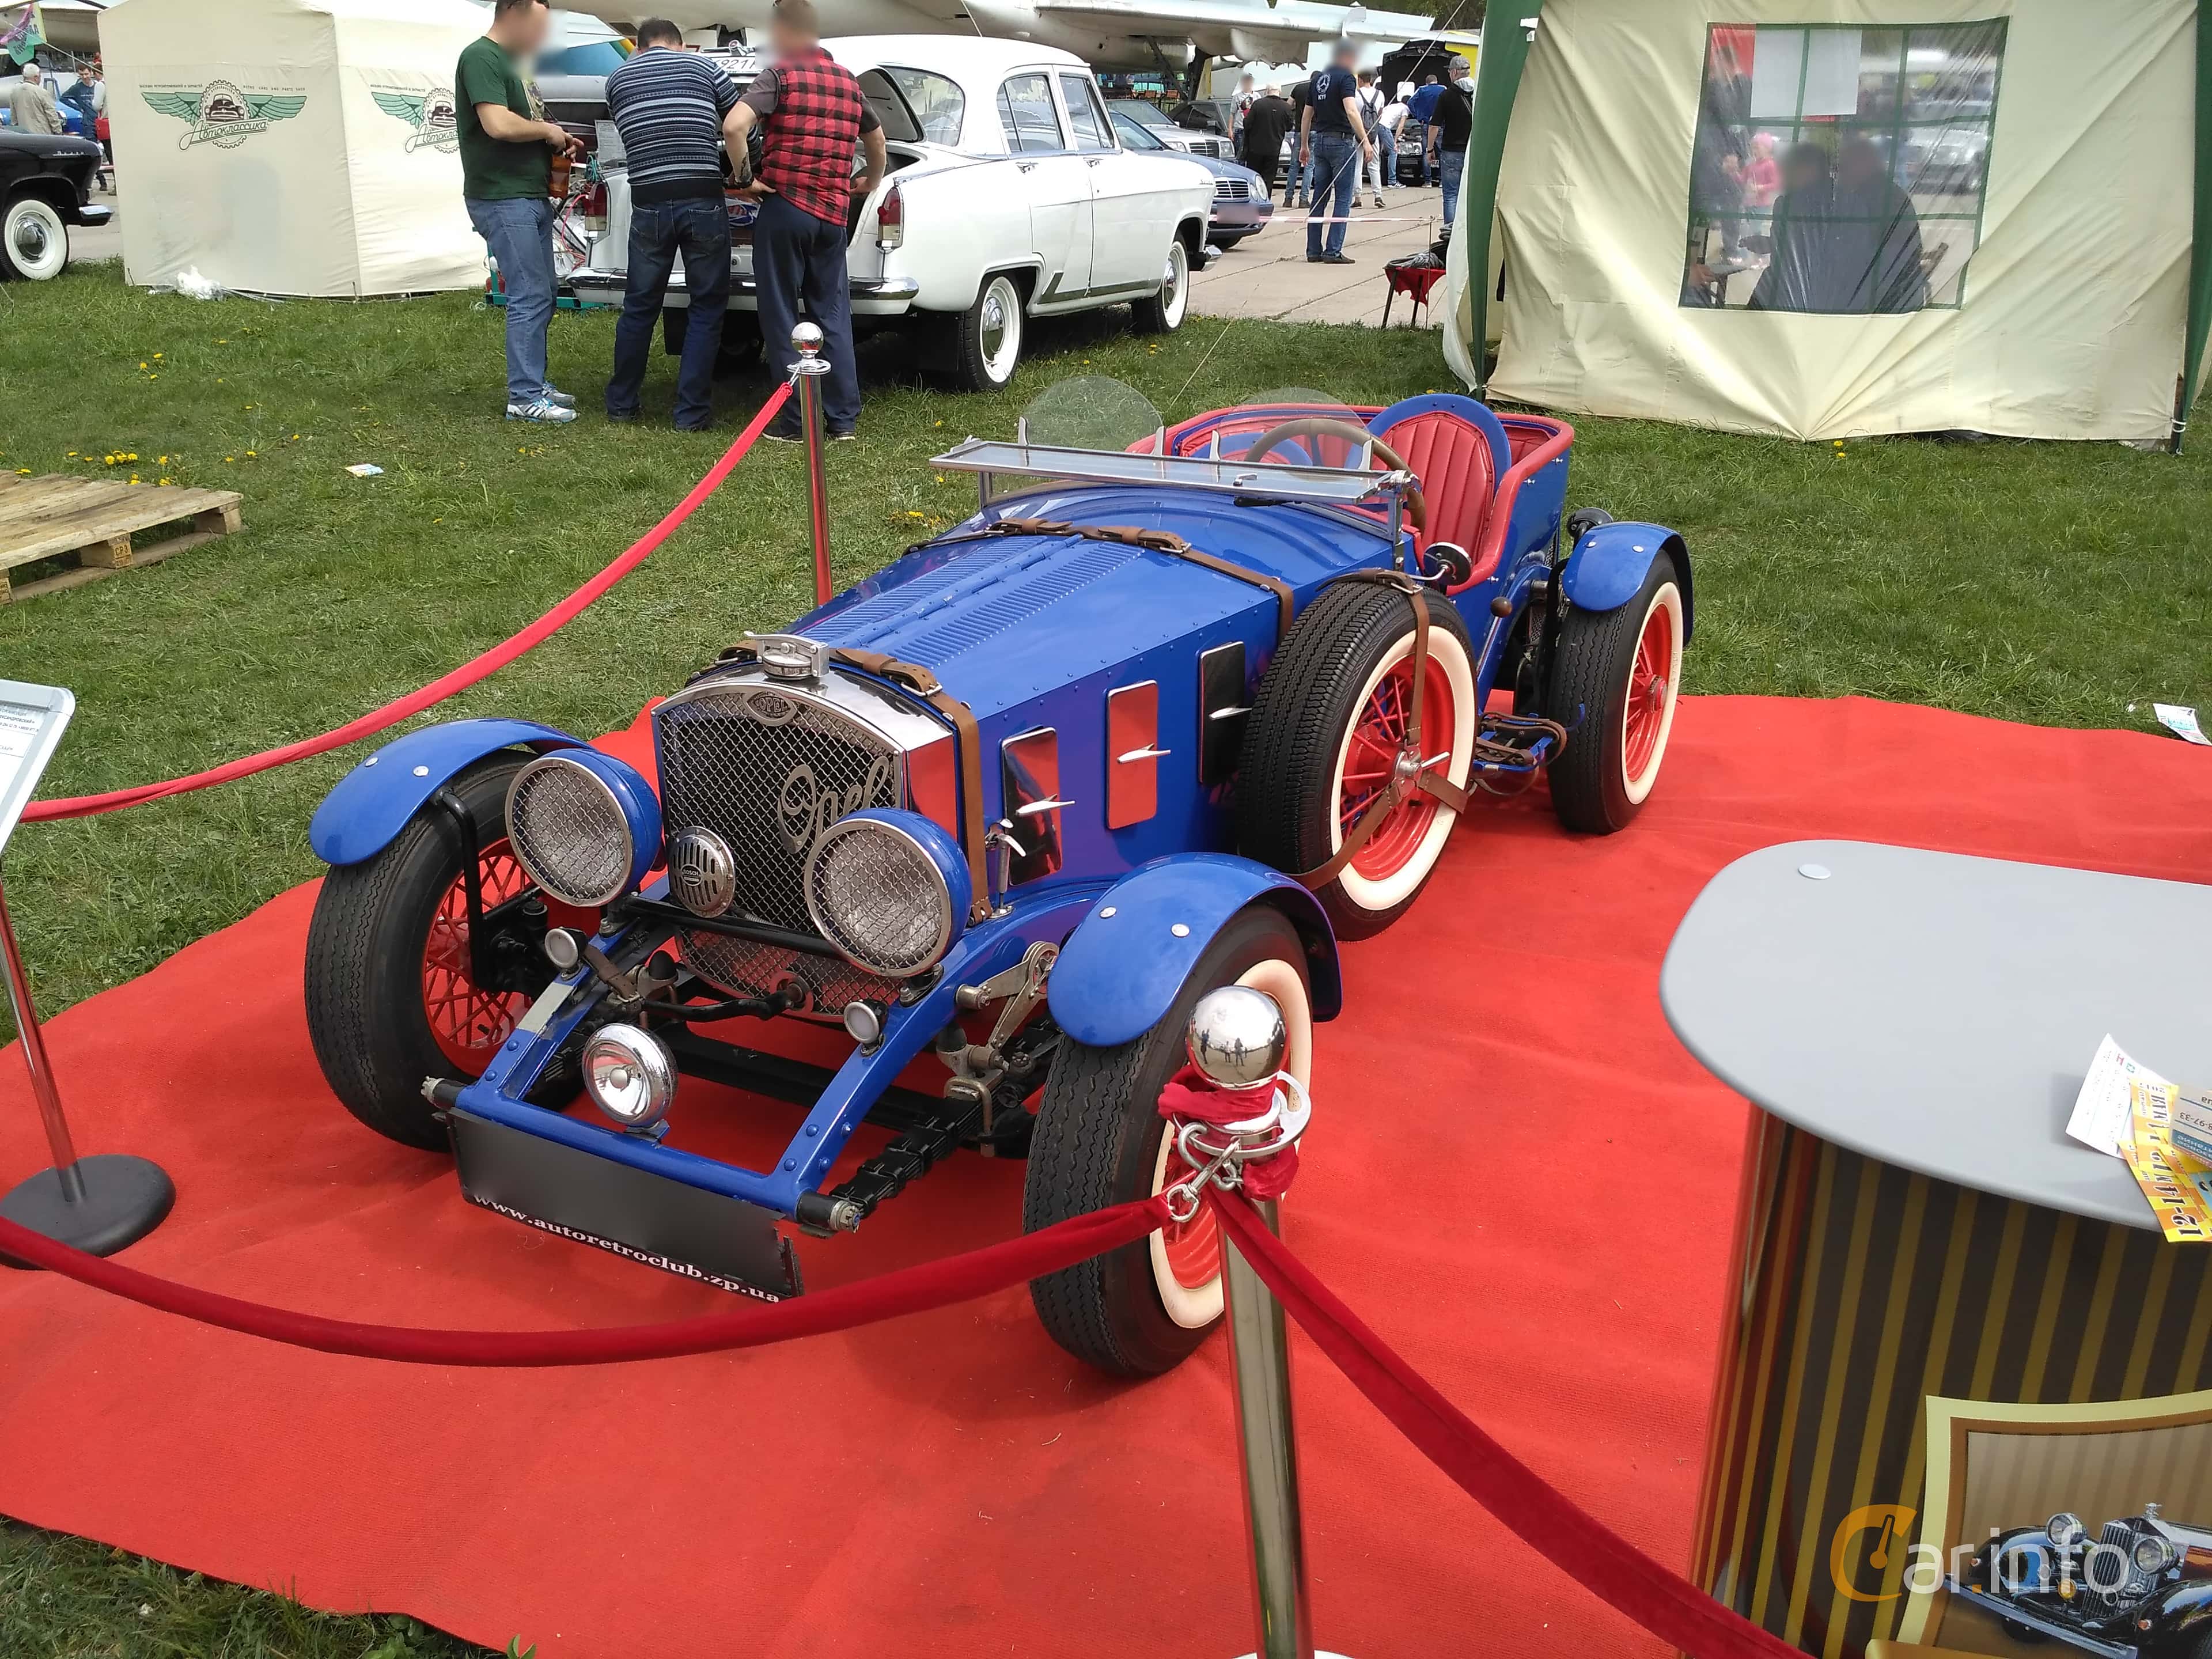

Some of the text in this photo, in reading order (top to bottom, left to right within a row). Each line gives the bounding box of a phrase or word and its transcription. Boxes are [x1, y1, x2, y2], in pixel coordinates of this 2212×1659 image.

[179, 119, 267, 150] Автоклассика
[759, 696, 789, 713] OPEL
[778, 756, 889, 854] Opel
[2151, 1094, 2168, 1122] МАЯ
[2154, 1185, 2203, 1237] 12-14
[474, 1195, 779, 1303] www.autoretroclub.zp.ua
